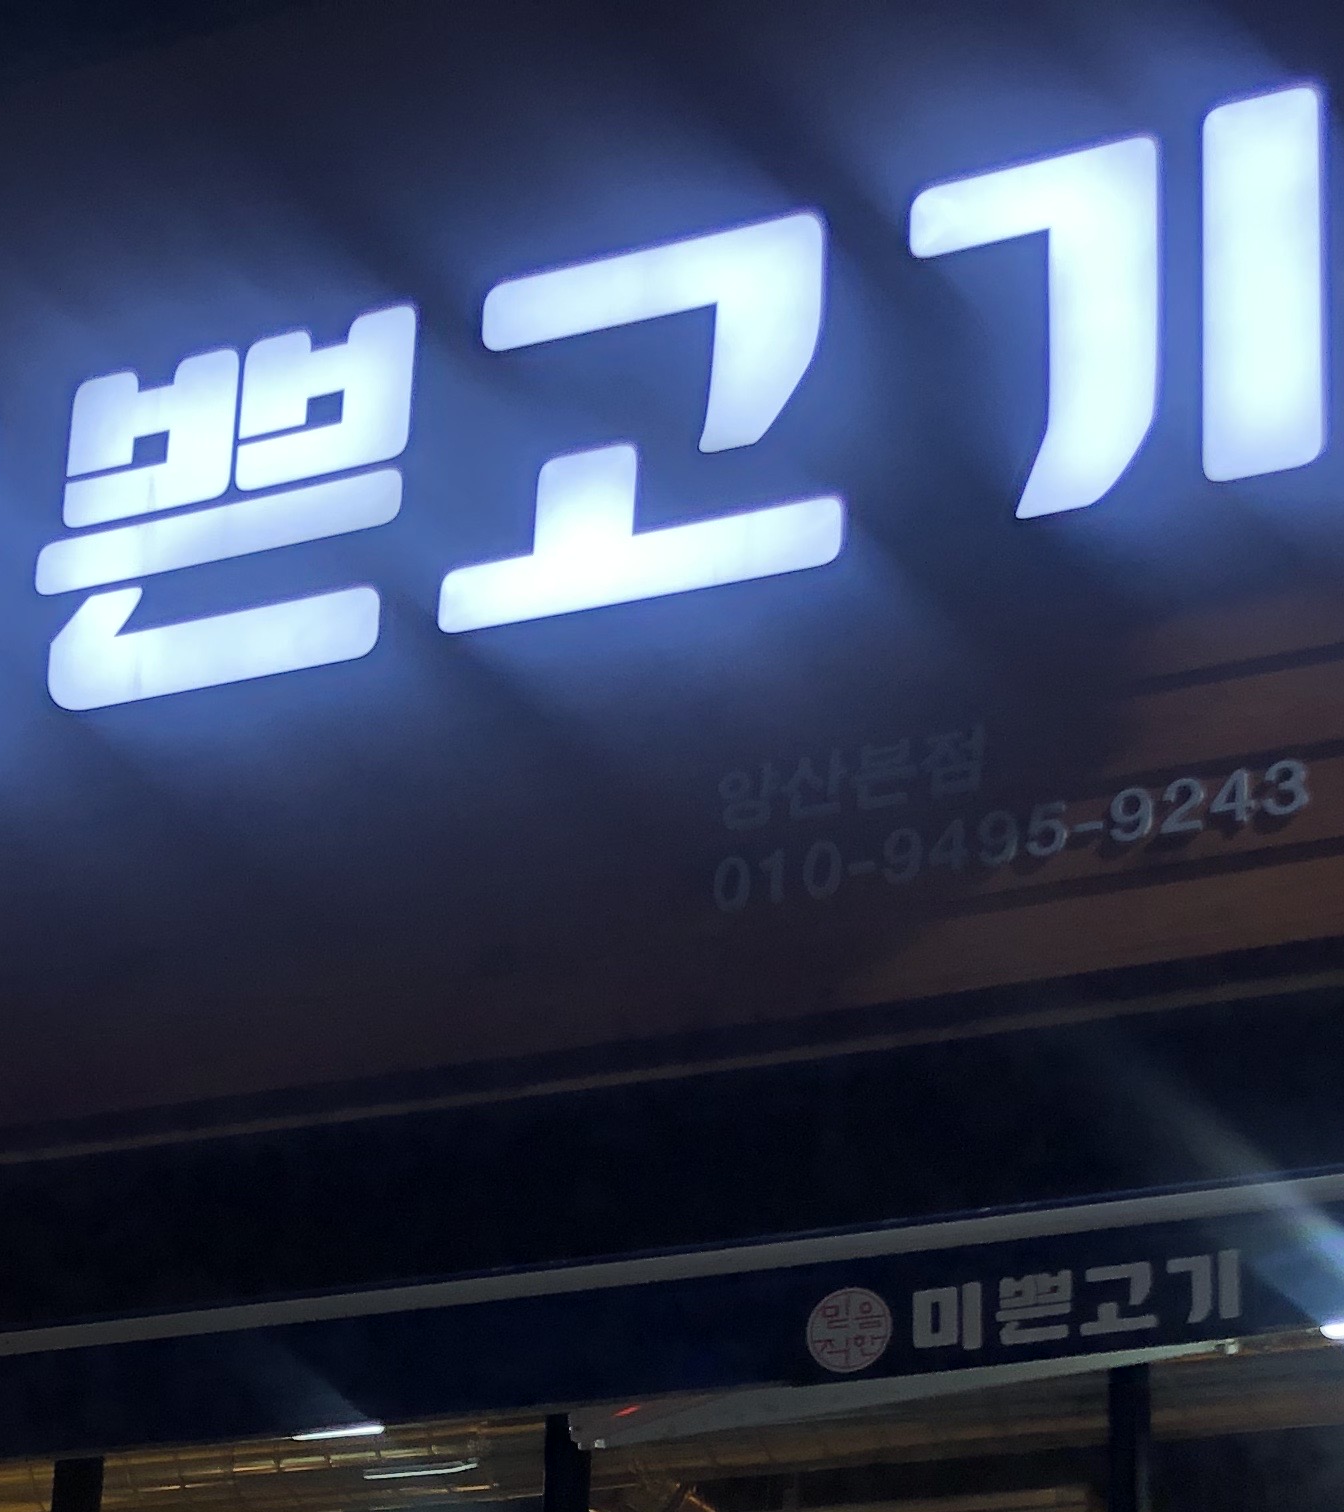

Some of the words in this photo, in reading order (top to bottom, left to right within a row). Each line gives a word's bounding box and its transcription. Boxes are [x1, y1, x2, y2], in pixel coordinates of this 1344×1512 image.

[712, 757, 1312, 914] 010-9495-9243
[819, 1298, 886, 1334] 믿음
[912, 1247, 1242, 1350] 미쁜고기
[812, 1334, 885, 1370] 직한
